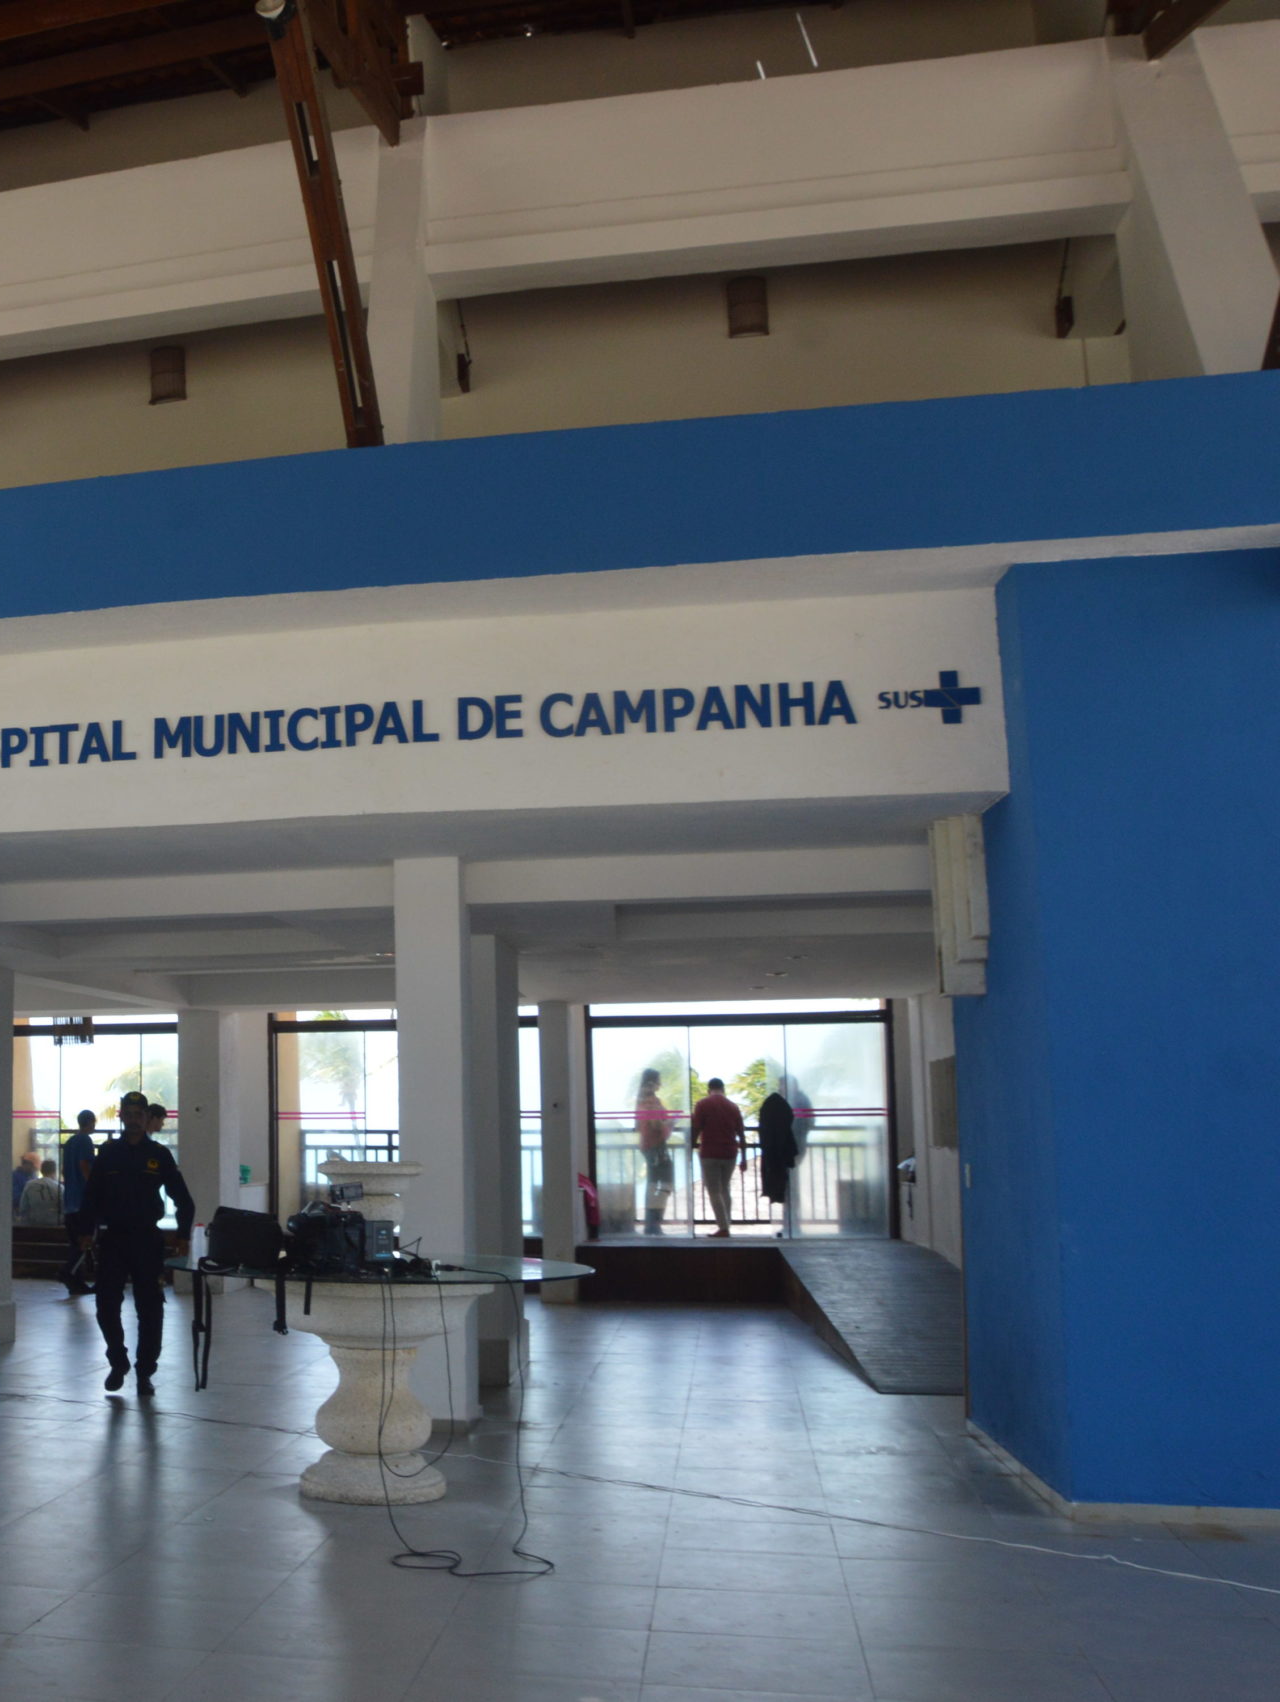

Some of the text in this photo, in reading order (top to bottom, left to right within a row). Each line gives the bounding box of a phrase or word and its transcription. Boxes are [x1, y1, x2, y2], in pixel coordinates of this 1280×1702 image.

[153, 700, 439, 759] MUNICIPAL
[458, 695, 523, 740] DE
[540, 680, 857, 737] CAMPANHA
[878, 690, 923, 709] SUS
